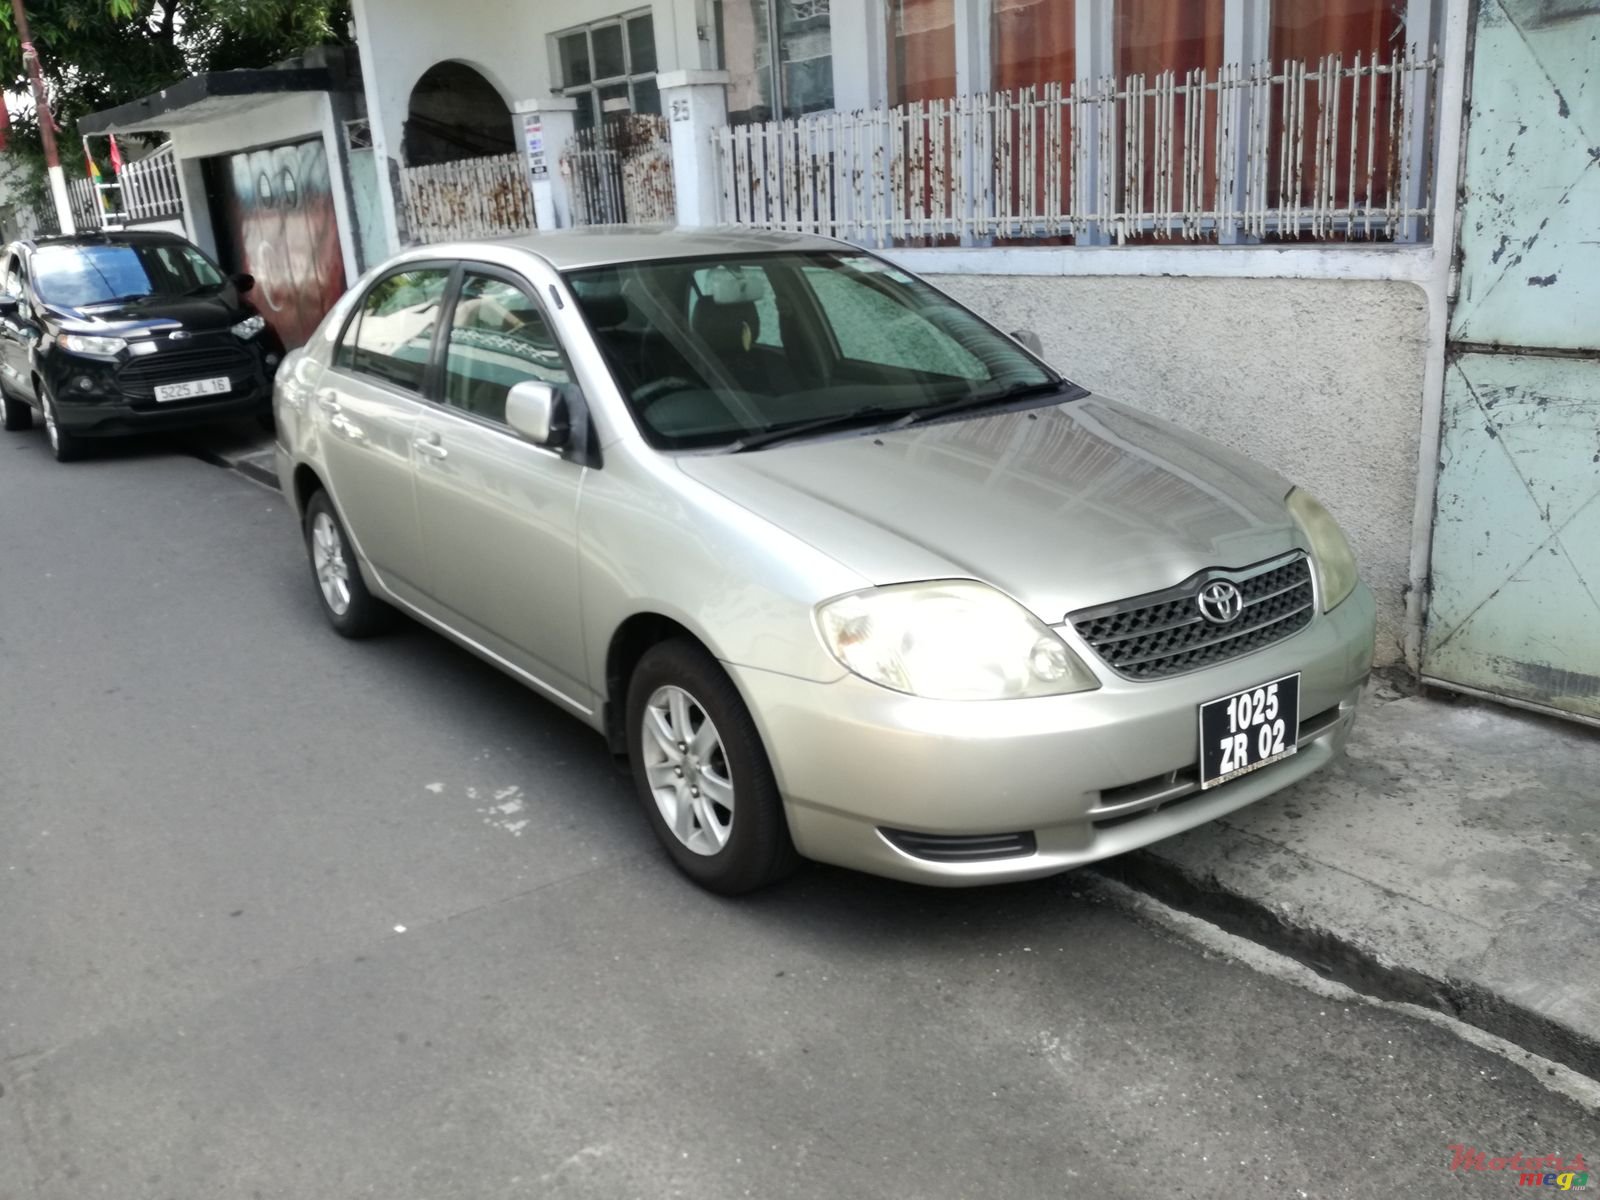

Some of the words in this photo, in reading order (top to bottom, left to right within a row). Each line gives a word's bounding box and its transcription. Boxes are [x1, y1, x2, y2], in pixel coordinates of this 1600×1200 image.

[161, 384, 190, 399] 5225
[195, 382, 207, 393] JL
[1227, 684, 1278, 733] 1025
[1220, 733, 1248, 774] ZR
[1258, 719, 1285, 759] 02
